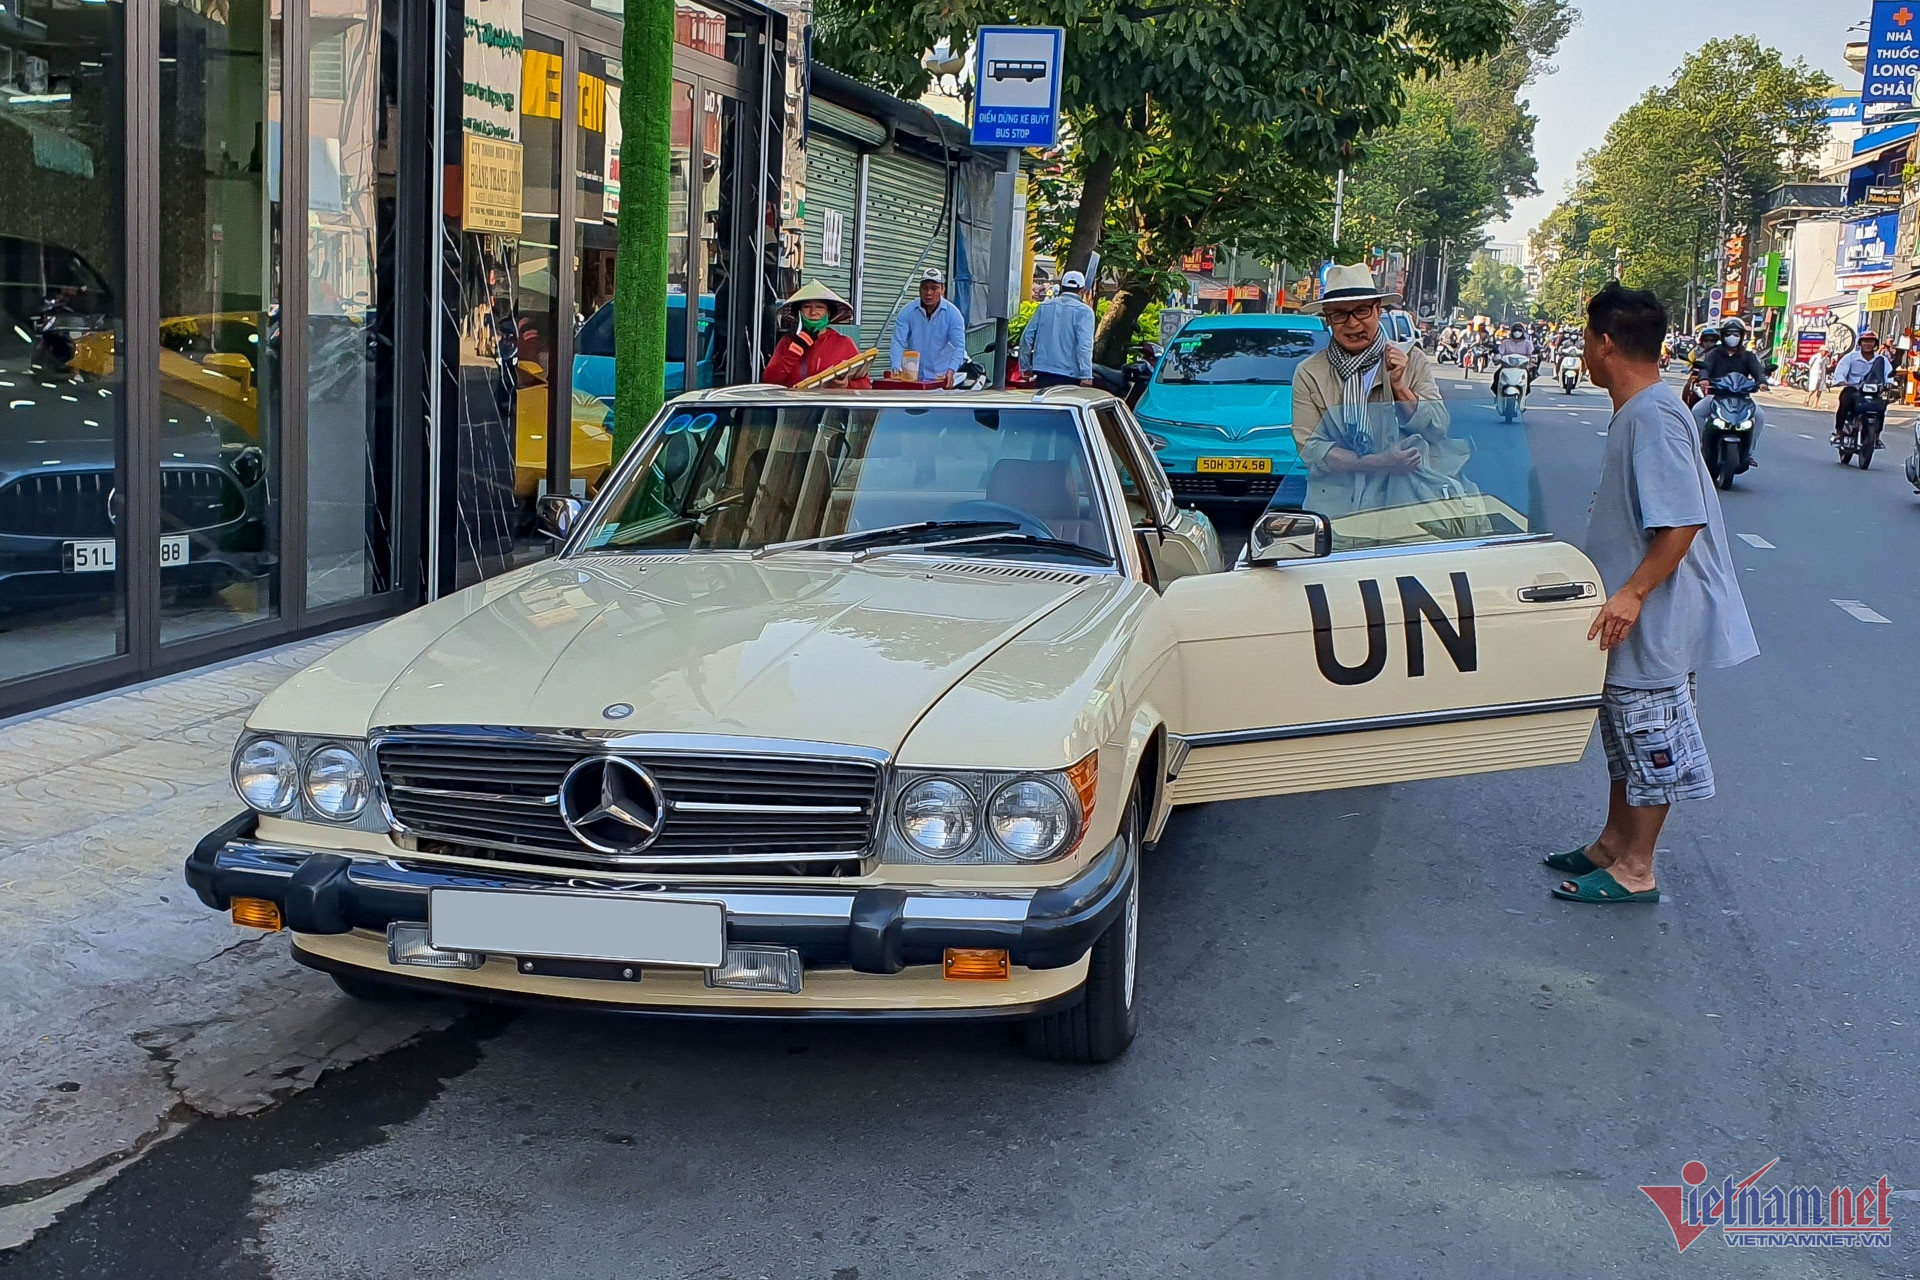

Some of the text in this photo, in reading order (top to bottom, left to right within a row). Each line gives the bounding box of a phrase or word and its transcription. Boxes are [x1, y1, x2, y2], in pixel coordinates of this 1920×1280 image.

[1886, 30, 1913, 42] NHÀ
[1876, 46, 1920, 59] THUỐC
[1872, 64, 1919, 77] LONG
[979, 109, 1049, 125] ĐIỂM DỪNG XE BUÝT
[995, 128, 1030, 139] BUS STOP
[76, 543, 181, 567] 51L 88
[1304, 571, 1477, 686] UN
